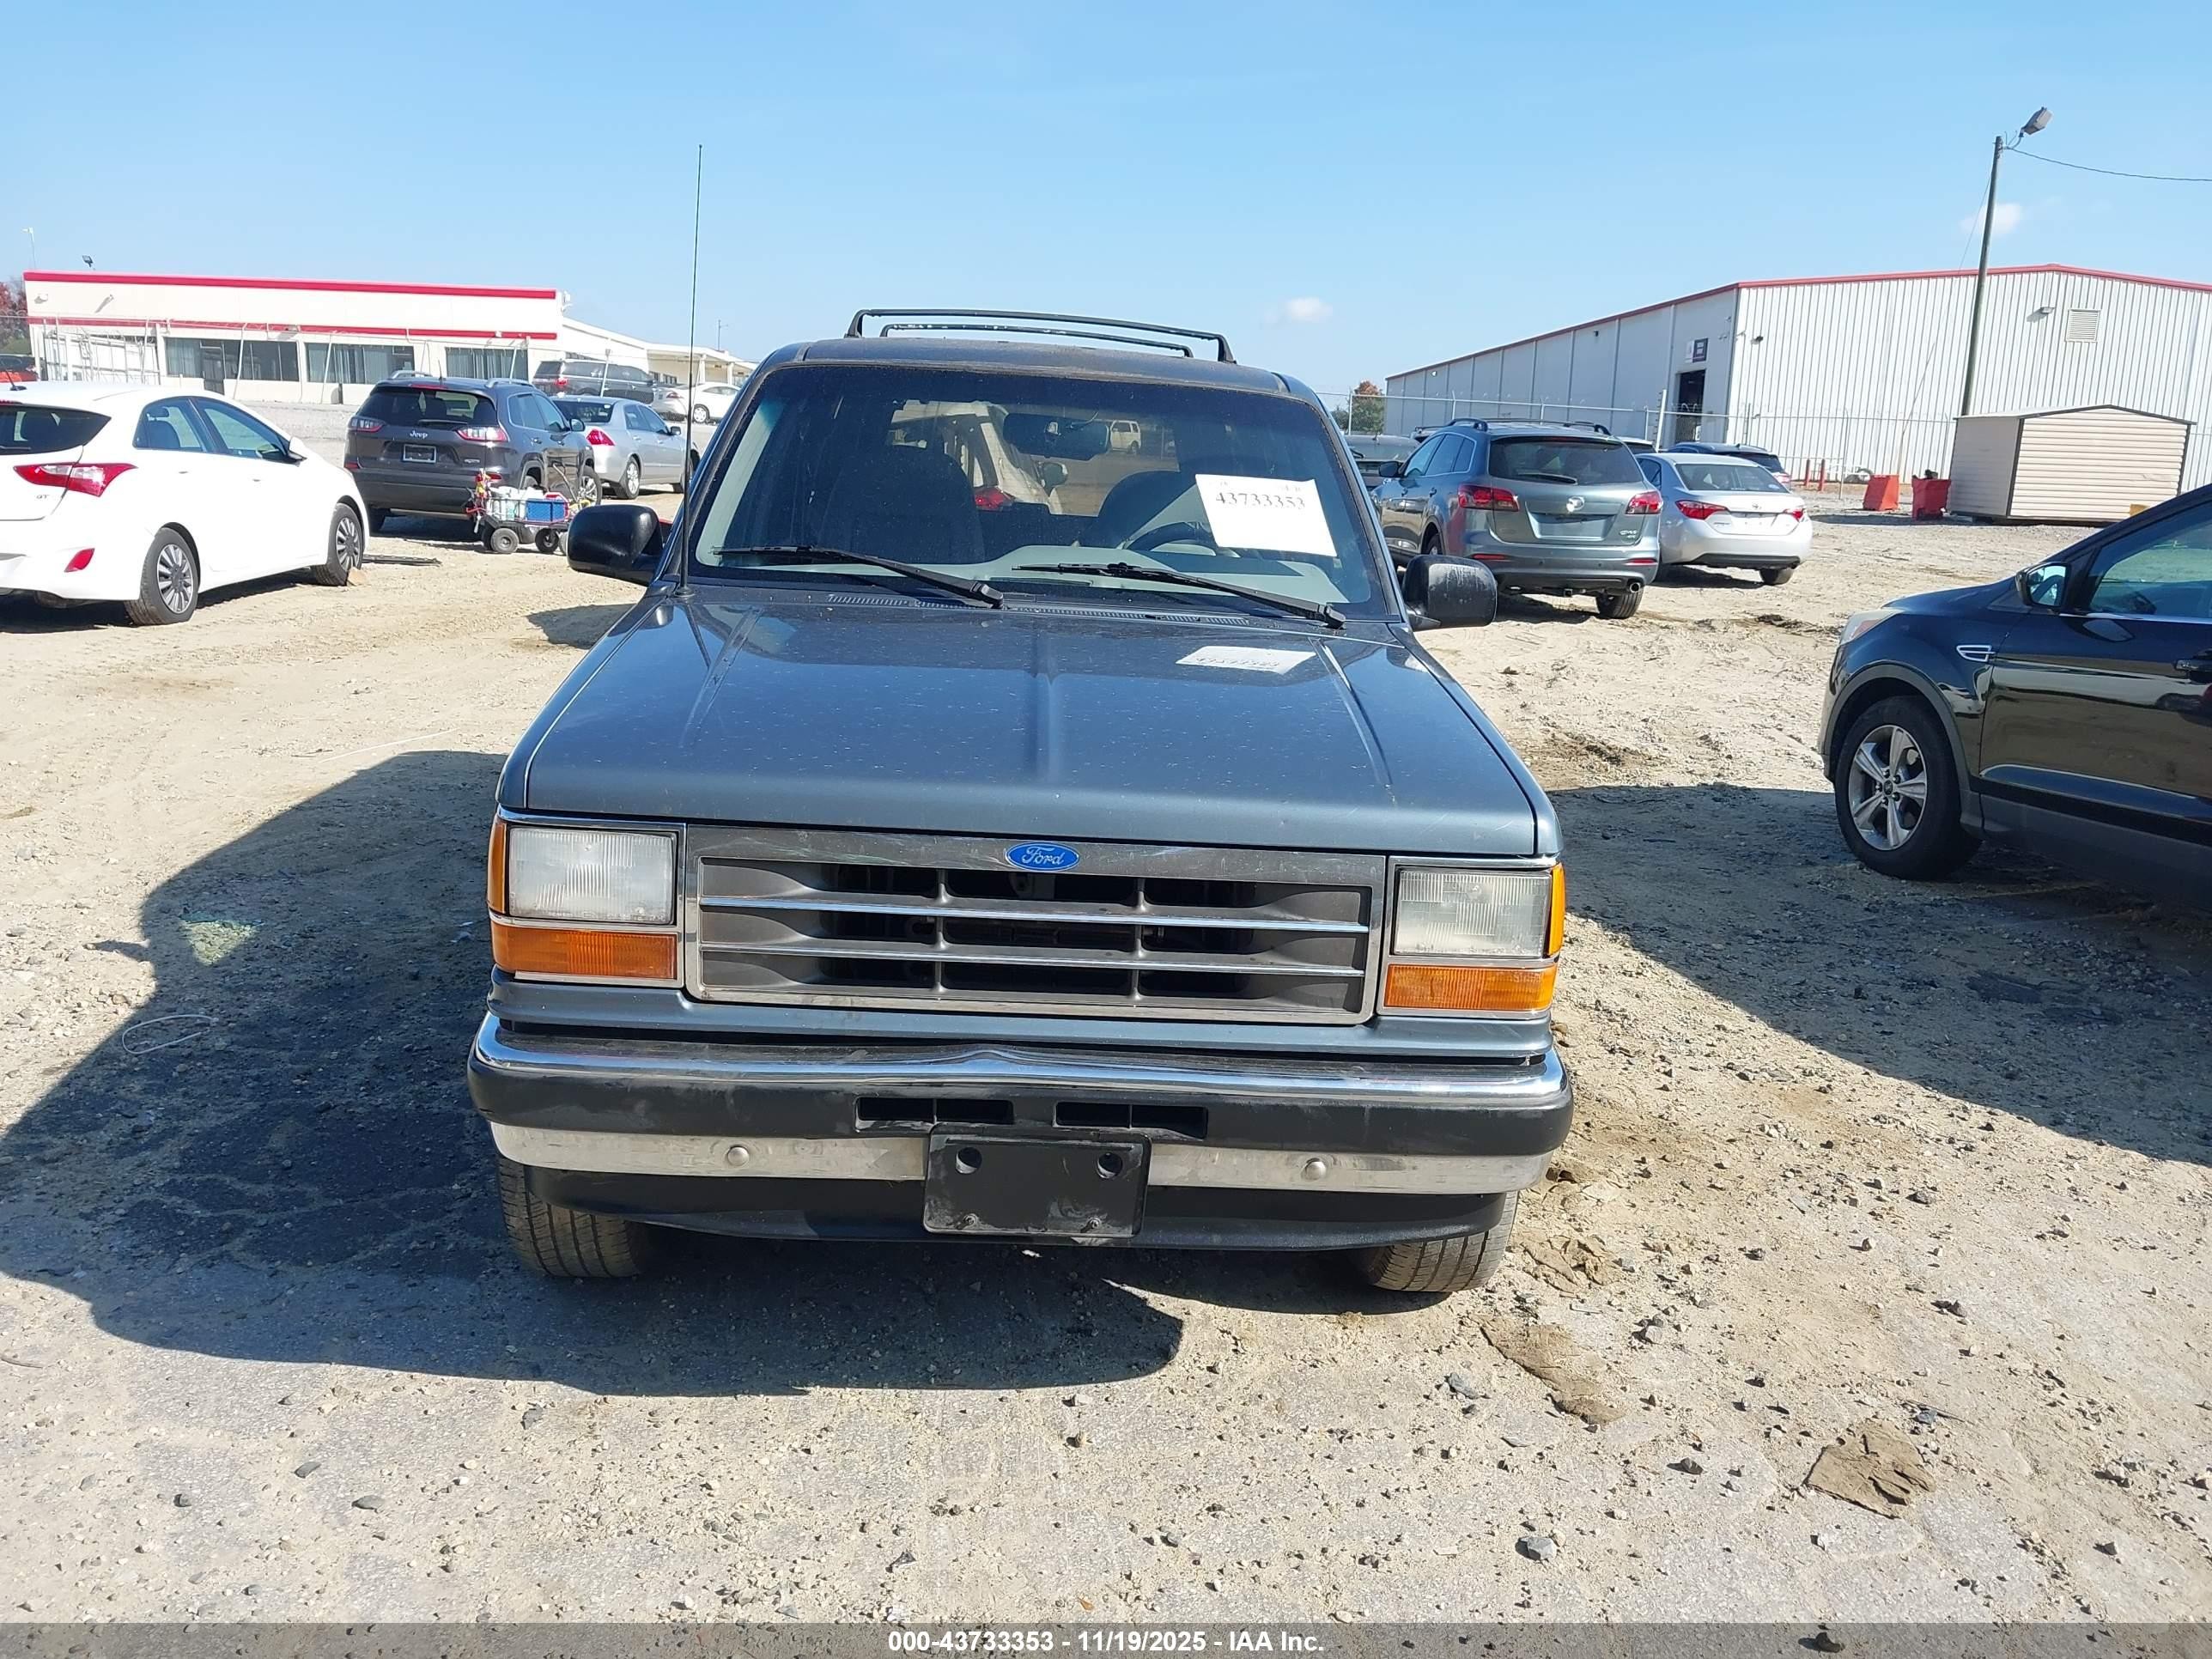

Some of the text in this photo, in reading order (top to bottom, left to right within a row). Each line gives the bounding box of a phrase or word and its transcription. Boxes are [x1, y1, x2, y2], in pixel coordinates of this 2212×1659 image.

[410, 429, 428, 440] Jeep
[1216, 491, 1305, 509] 43733353
[1021, 846, 1066, 865] Ford
